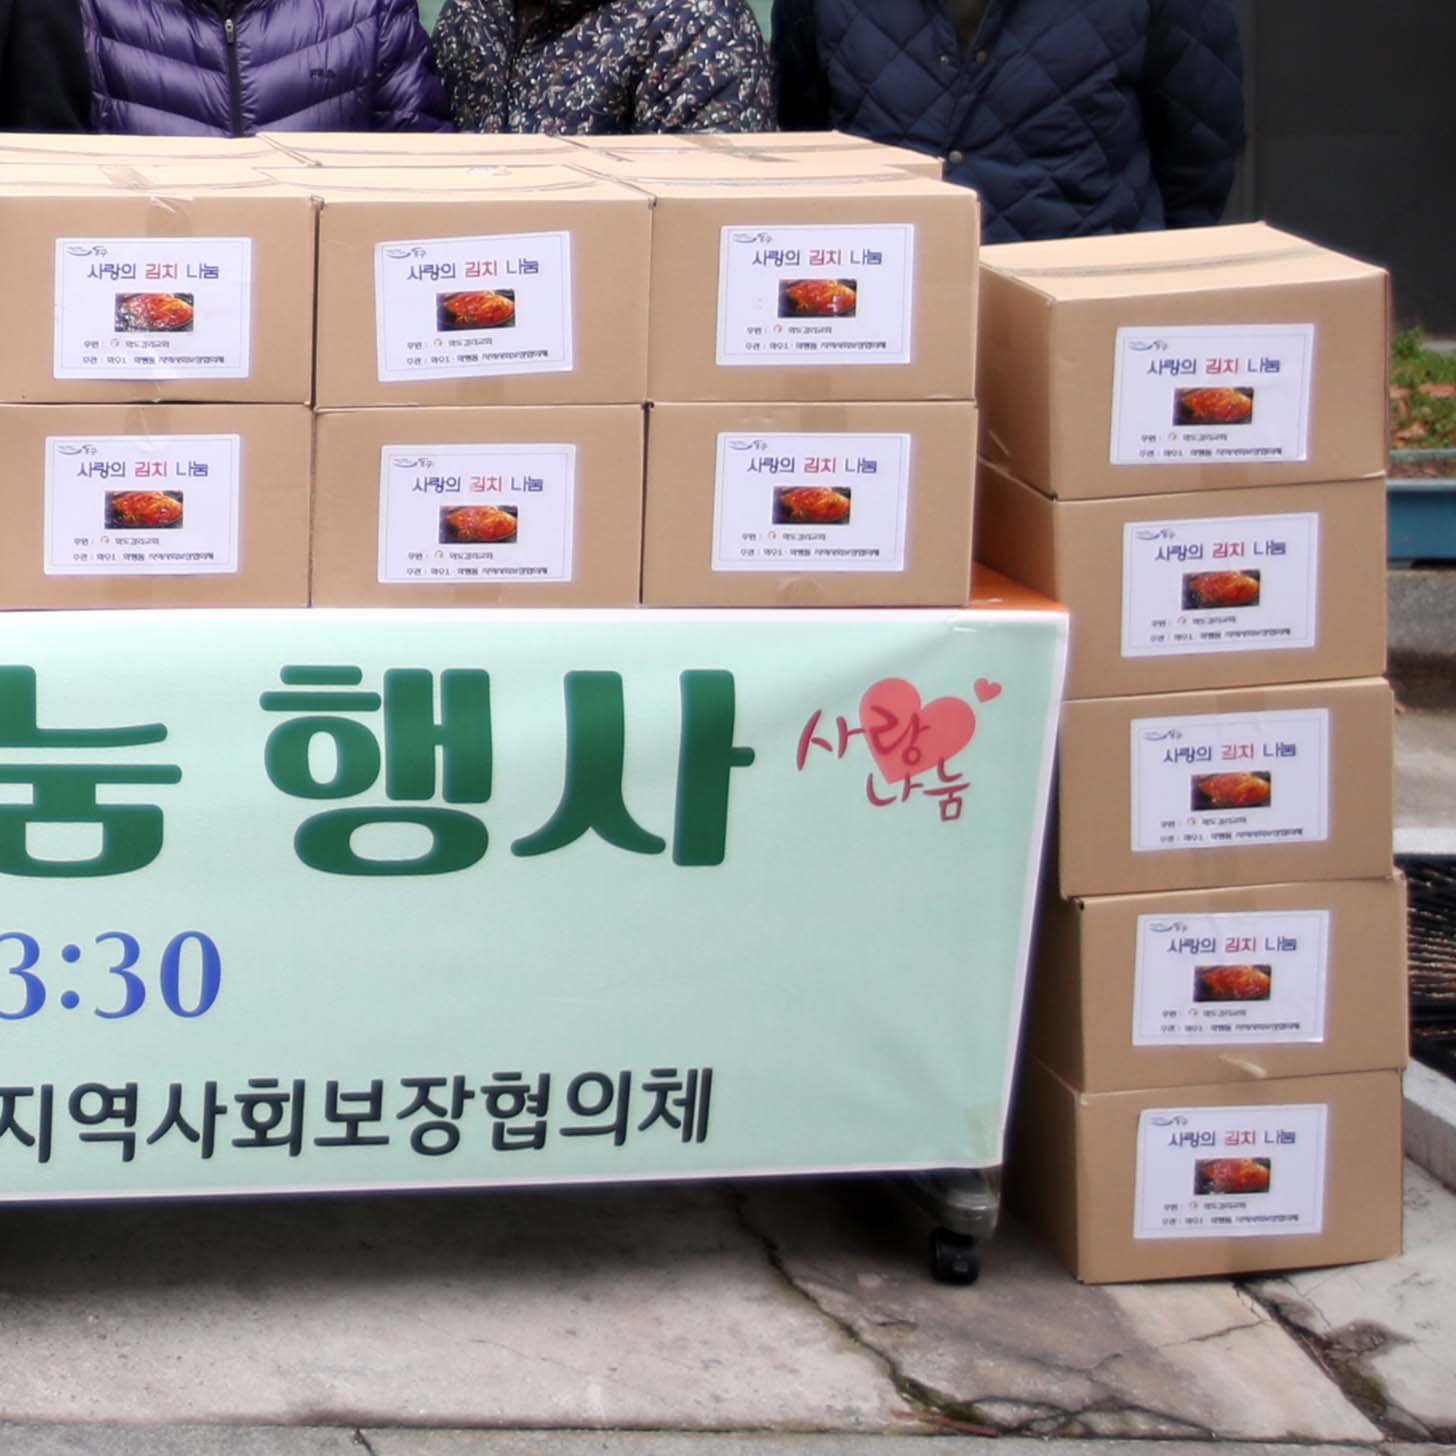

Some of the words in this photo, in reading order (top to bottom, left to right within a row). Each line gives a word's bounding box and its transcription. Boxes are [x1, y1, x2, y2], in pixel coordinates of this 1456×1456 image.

[751, 249, 801, 268] 사랑의
[808, 249, 842, 266] 김치
[850, 248, 883, 266] 나눔
[87, 263, 137, 281] 사랑의
[145, 263, 178, 280] 김치
[186, 262, 220, 280] 나눔
[407, 262, 457, 282] 사랑의
[465, 260, 498, 278] 김치
[506, 257, 540, 275] 나눔
[1205, 357, 1240, 375] 김치
[76, 461, 126, 480] 사랑의
[134, 460, 168, 478] 김치
[175, 460, 209, 478] 나눔
[747, 456, 796, 475] 사랑의
[803, 456, 837, 474] 김치
[844, 457, 878, 475] 나눔
[411, 476, 461, 494] 사랑의
[470, 475, 503, 493] 김치
[510, 475, 544, 493] 나눔
[1212, 541, 1245, 559] 김치
[796, 705, 930, 772] 사랑
[1221, 743, 1255, 761] 김치
[260, 666, 756, 877] 행사
[866, 756, 971, 823] 나눔
[1224, 936, 1257, 954] 김치
[1224, 1130, 1257, 1147] 김치
